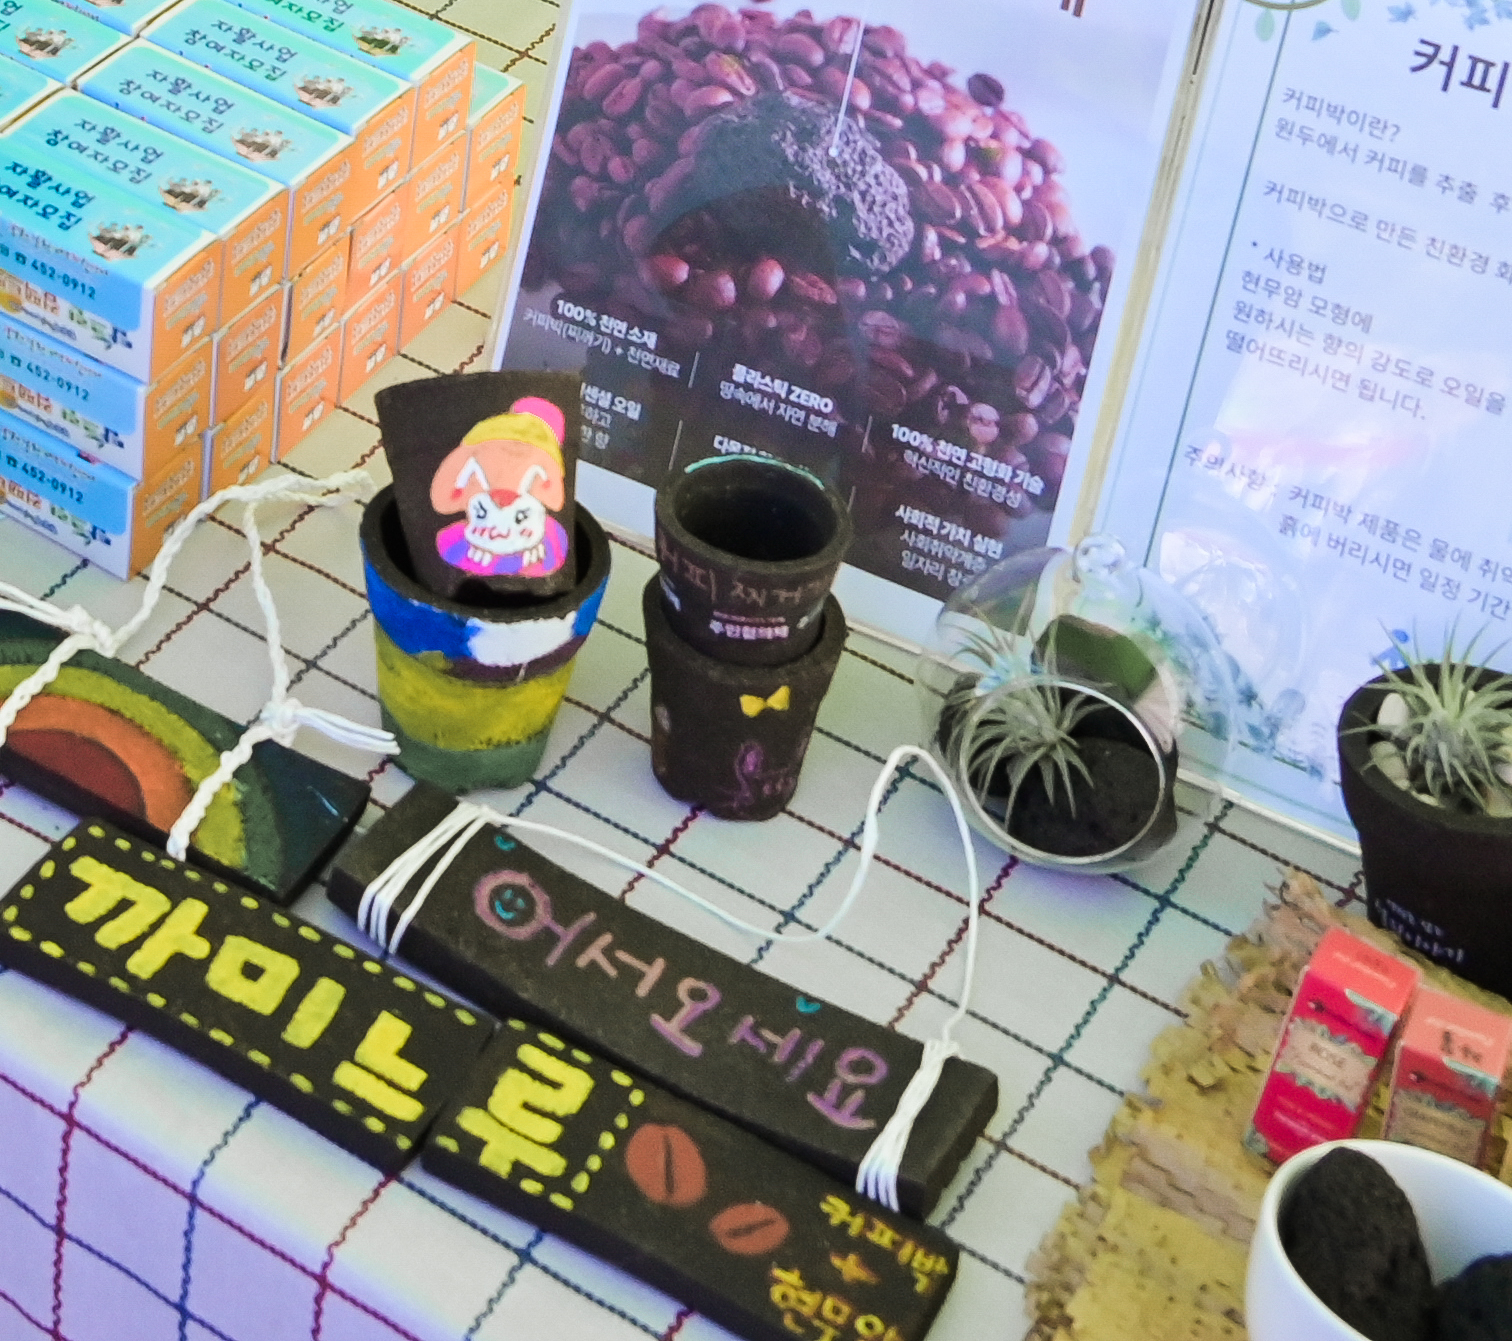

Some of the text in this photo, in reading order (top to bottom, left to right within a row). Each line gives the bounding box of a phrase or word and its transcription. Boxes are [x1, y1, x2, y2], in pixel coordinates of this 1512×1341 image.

[211, 19, 298, 63] 자활사업
[146, 69, 235, 115] 자활사업
[1282, 86, 1401, 142] 커피박이란?
[74, 118, 164, 164] 자활사업
[5, 161, 96, 209] 자활사업
[1275, 117, 1359, 163] 원두에서
[1364, 149, 1429, 187] 커피를
[1436, 174, 1477, 205] 추출
[1490, 192, 1512, 214] 후
[1263, 180, 1370, 233] 커피박으로
[1376, 219, 1418, 250] 만든
[1425, 236, 1490, 275] 친환경
[31, 259, 97, 300] 452-0912
[1263, 247, 1328, 285] 사용법
[556, 299, 598, 327] 100%
[1241, 270, 1374, 335] 현무암 모형에
[1225, 328, 1352, 393] 떨어뜨리시면
[1233, 300, 1506, 416] 원하시는 향의 강도로 오일을
[27, 363, 90, 401] 452-0912
[790, 389, 835, 414] ZERO
[891, 423, 935, 453] 100%
[22, 463, 84, 504] 452-0912
[1289, 484, 1354, 525] 커피박
[1357, 512, 1424, 553] 제품은
[1326, 533, 1412, 583] 버리시면
[1419, 565, 1463, 601] 일정
[1467, 587, 1512, 621] 기간
[474, 869, 889, 1130] 어서오세요
